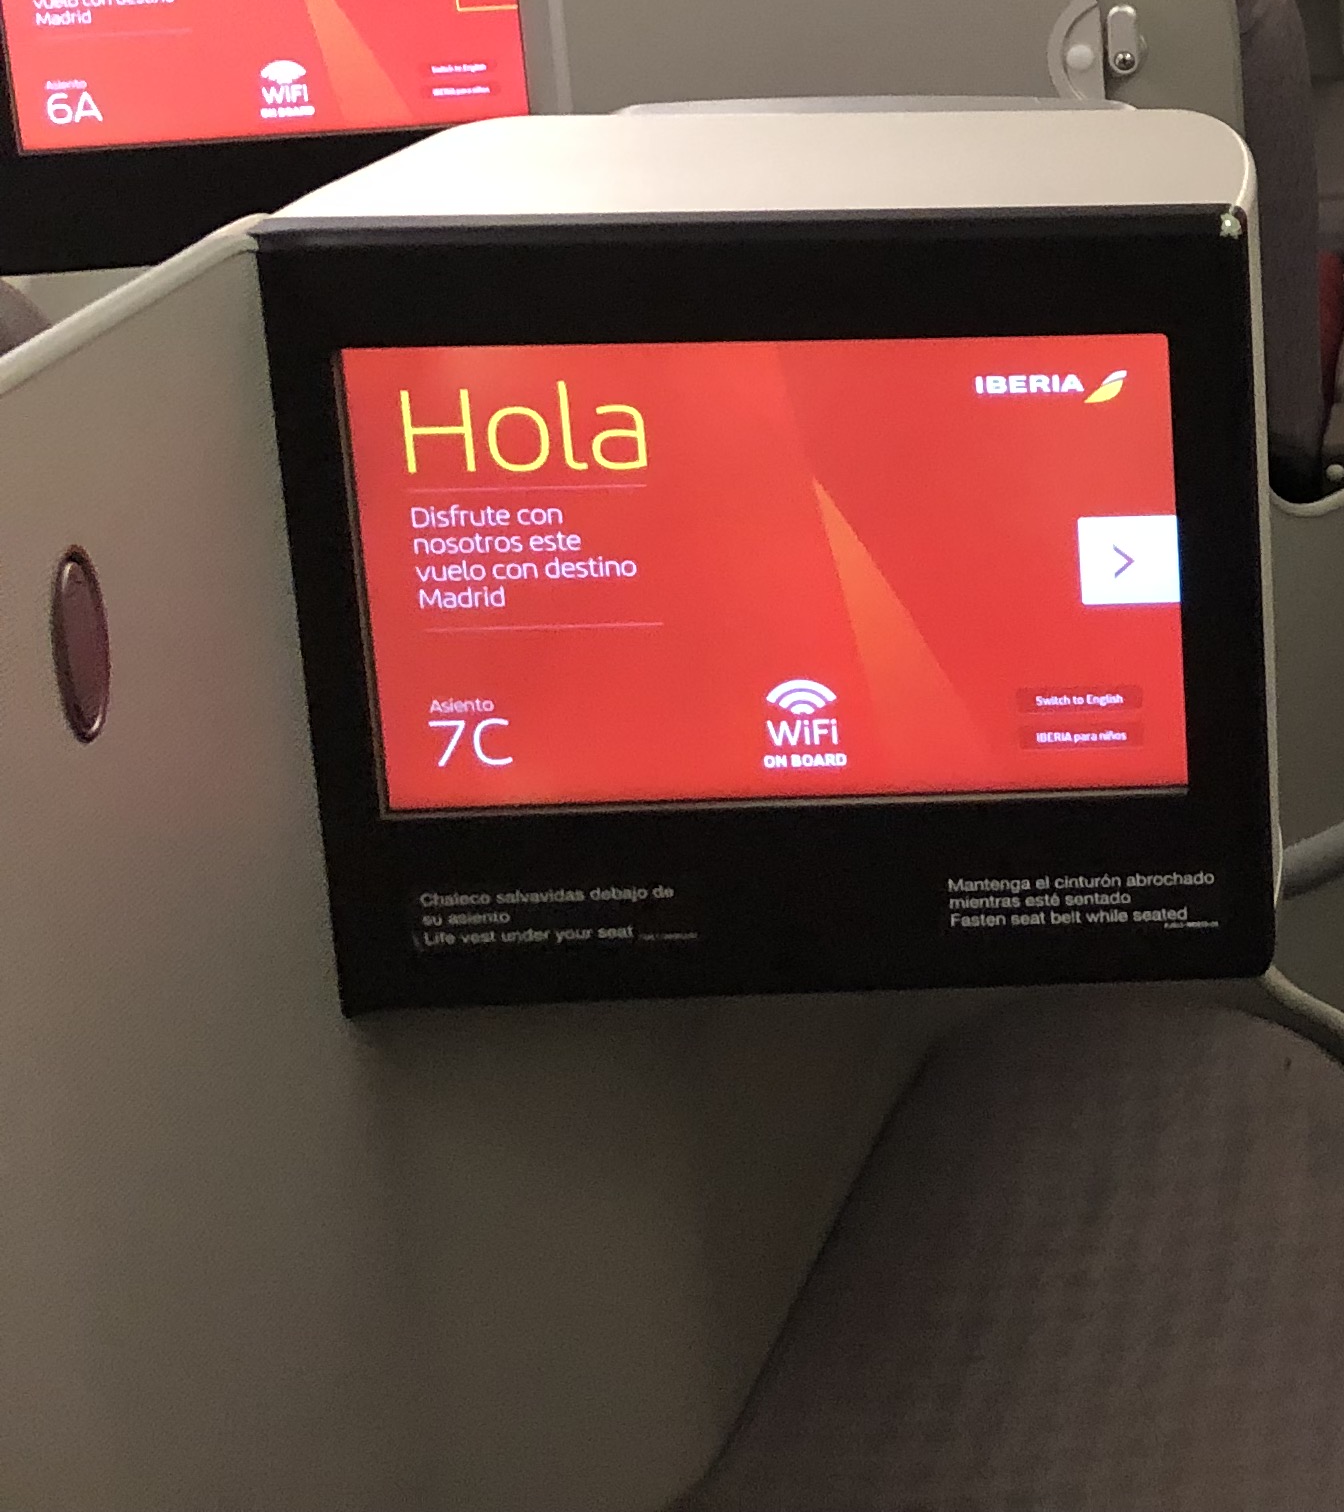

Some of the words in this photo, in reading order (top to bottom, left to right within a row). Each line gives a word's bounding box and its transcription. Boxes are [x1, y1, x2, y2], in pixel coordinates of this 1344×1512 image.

[36, 9, 92, 26] Madrid
[262, 84, 309, 104] WiFi
[47, 92, 103, 124] 6A
[975, 374, 1084, 394] IBERIA
[400, 381, 647, 473] Hola
[411, 504, 510, 529] Disfrute
[517, 507, 563, 526] con
[413, 531, 522, 555] nosotros
[529, 530, 581, 551] este
[415, 560, 486, 582] vuelo
[492, 561, 538, 580] con
[545, 556, 637, 579] destino
[419, 585, 505, 608] Madrid
[430, 697, 494, 713] Asiento
[1035, 694, 1070, 706] Switch
[1072, 695, 1084, 705] to
[1086, 693, 1124, 707] English
[429, 718, 513, 766] 7C
[767, 719, 838, 746] WiFi
[1036, 732, 1072, 743] IBERIA
[1074, 733, 1097, 744] para
[764, 753, 788, 768] ON
[791, 751, 847, 767] BOARD
[948, 877, 1030, 893] Mantenga
[1035, 875, 1050, 890] el
[1054, 873, 1121, 889] cinturón
[1126, 871, 1215, 888] abrochado
[420, 892, 490, 907] Chaleco
[496, 888, 584, 904] salvavidas
[590, 887, 648, 902] debajo
[652, 885, 674, 899] de
[949, 896, 1021, 910] mientras
[1025, 892, 1060, 907] esté
[1065, 891, 1132, 906] sentado
[422, 915, 442, 927] su
[448, 911, 510, 925] asiento
[950, 913, 1006, 927] Fasten
[1011, 911, 1046, 926] seat
[1050, 909, 1081, 924] belt
[1086, 909, 1128, 923] while
[1132, 906, 1188, 922] seated
[424, 931, 456, 947] Life
[461, 931, 495, 944] vest
[501, 928, 549, 943] under
[555, 927, 593, 944] your
[598, 924, 634, 940] seat
